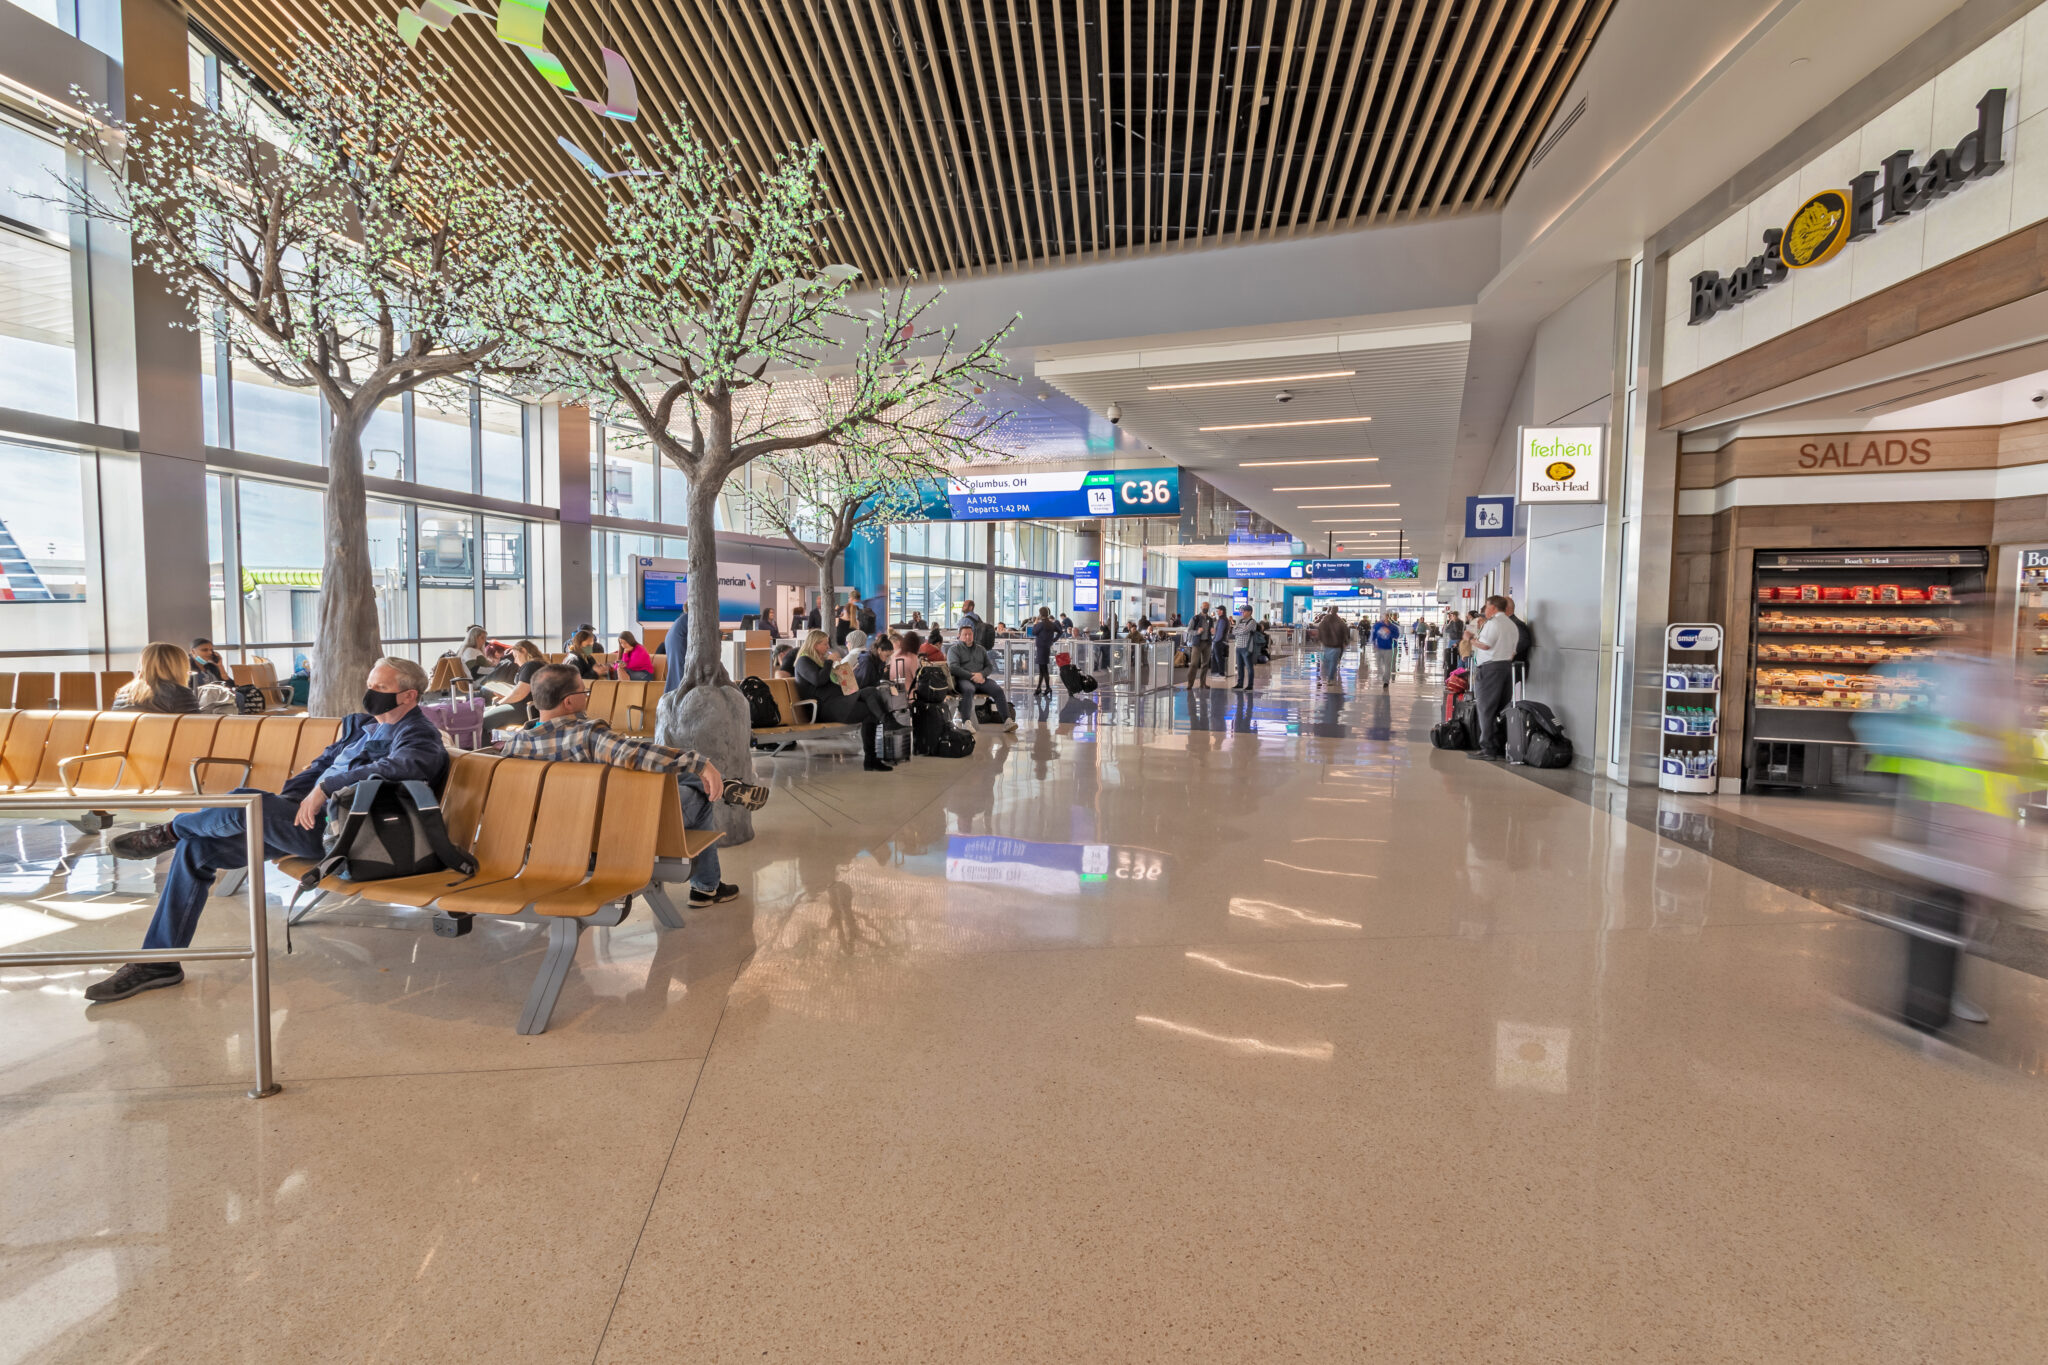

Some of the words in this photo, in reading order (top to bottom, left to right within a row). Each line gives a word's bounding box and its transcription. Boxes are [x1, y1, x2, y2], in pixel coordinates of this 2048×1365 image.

[1687, 227, 1789, 326] Boar's
[1846, 87, 2008, 242] Head
[1531, 435, 1592, 457] freshëns
[1797, 438, 1931, 469] SALADS
[1012, 478, 1027, 487] OH
[1532, 481, 1560, 492] Boar's
[1562, 481, 1589, 492] Head
[1094, 492, 1106, 502] 14
[1120, 480, 1171, 505] C36
[966, 496, 978, 505] AA
[979, 496, 997, 504] 1492
[968, 505, 999, 514] Departs
[1000, 504, 1015, 513] 1:42
[1017, 504, 1030, 512] PM
[640, 558, 653, 567] C36
[717, 576, 746, 586] merican
